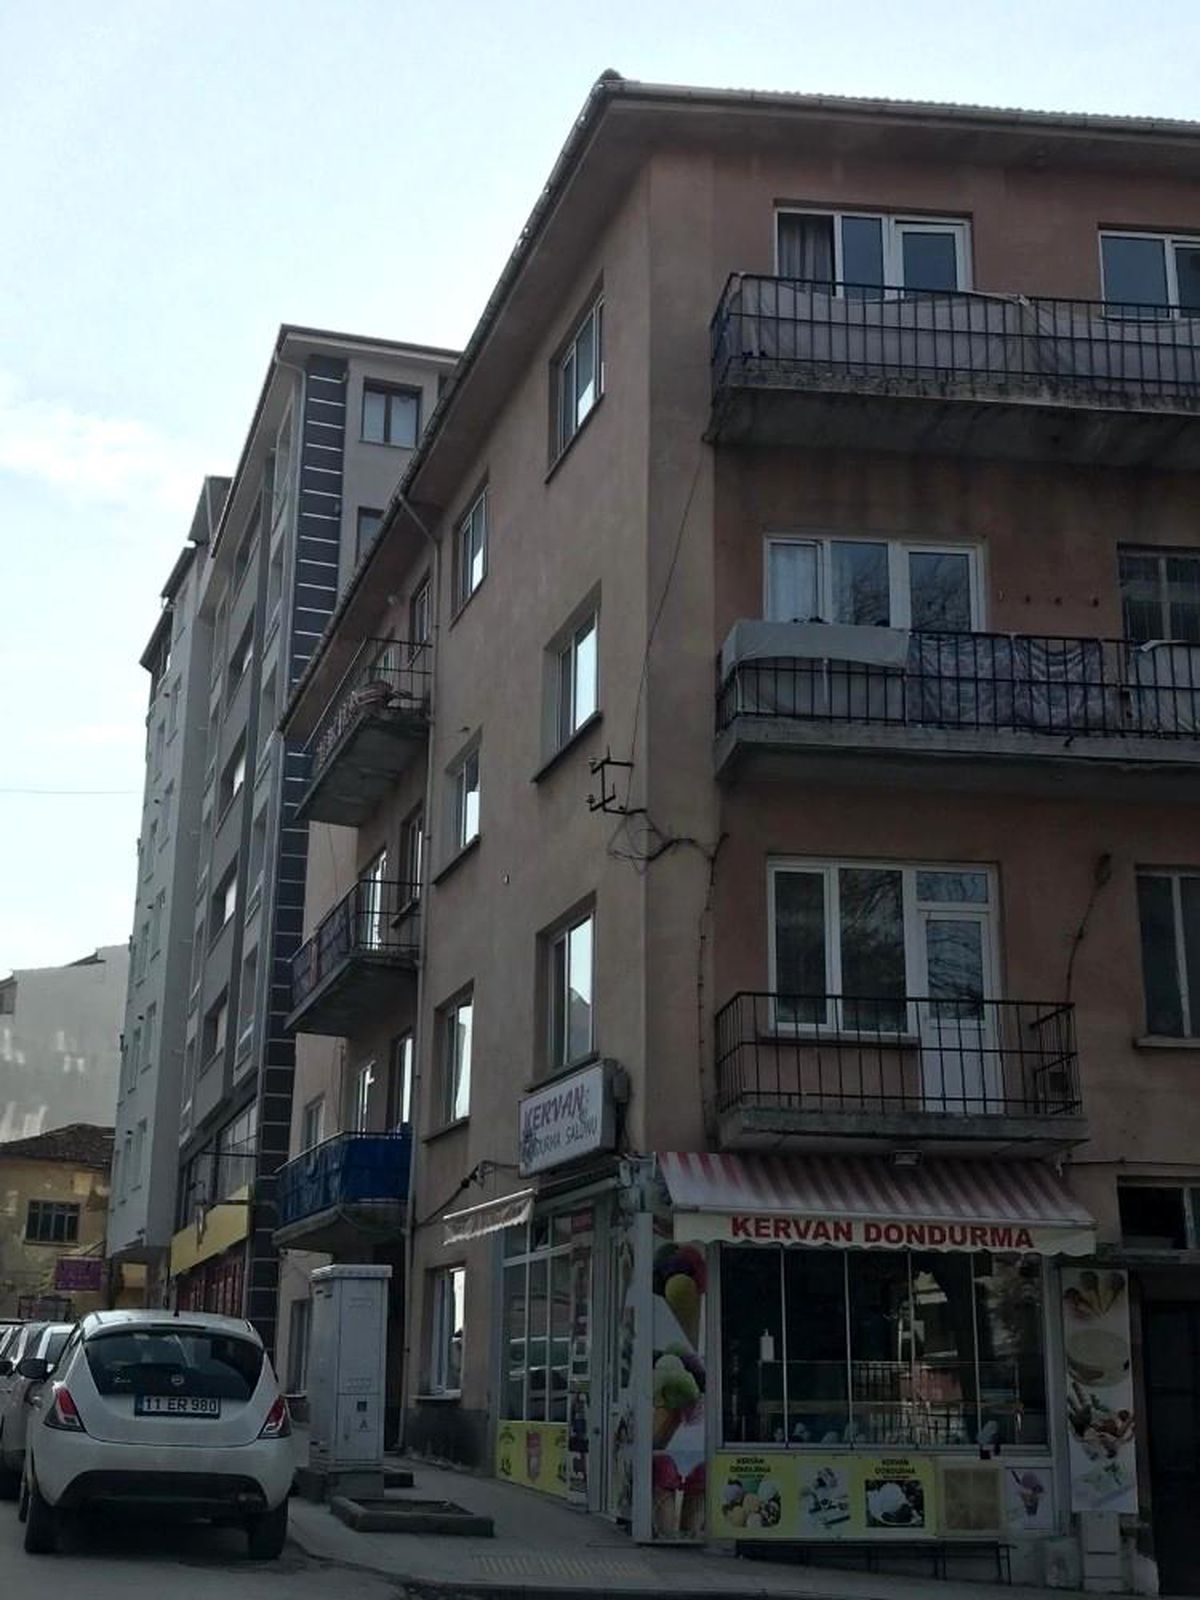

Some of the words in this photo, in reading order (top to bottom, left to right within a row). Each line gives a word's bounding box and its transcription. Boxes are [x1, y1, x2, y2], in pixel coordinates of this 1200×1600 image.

[524, 1084, 584, 1132] KERVAN
[732, 1215, 852, 1242] KERVAN
[863, 1223, 1034, 1249] DONDURMA
[146, 1398, 160, 1410] 11
[168, 1398, 187, 1411] ER
[191, 1399, 217, 1412] 980
